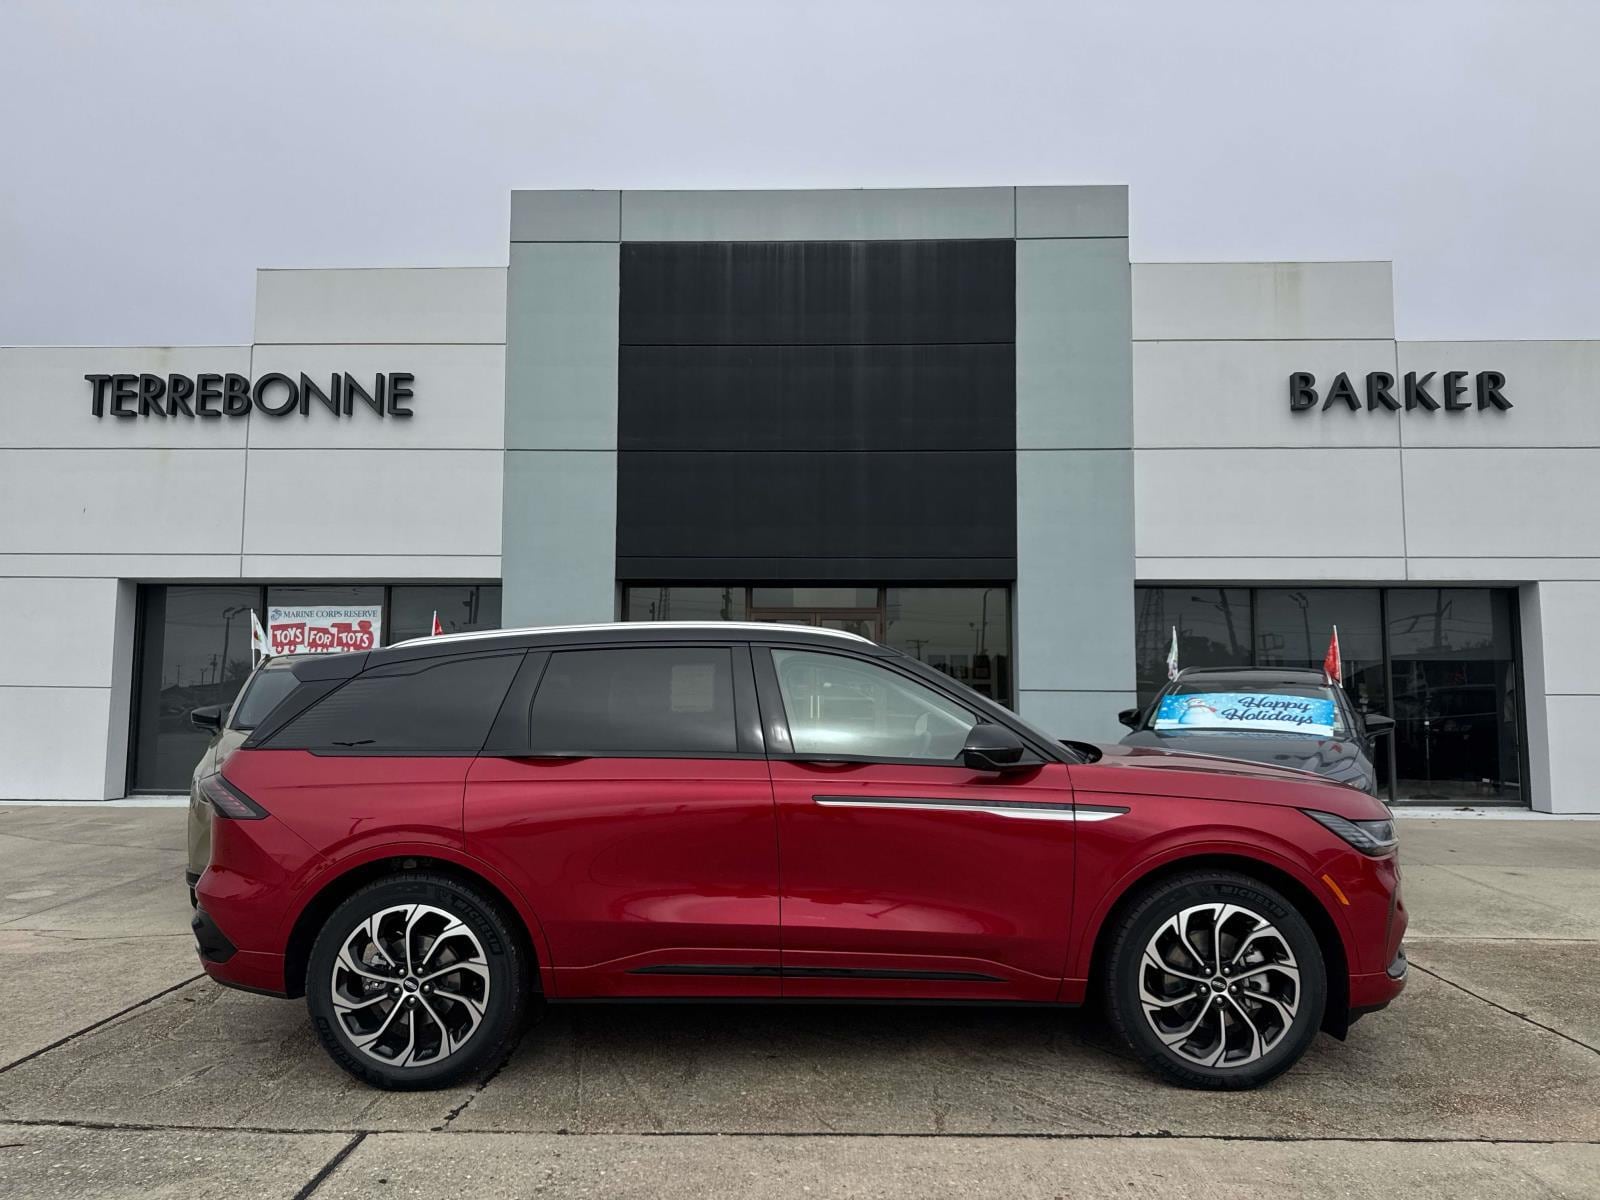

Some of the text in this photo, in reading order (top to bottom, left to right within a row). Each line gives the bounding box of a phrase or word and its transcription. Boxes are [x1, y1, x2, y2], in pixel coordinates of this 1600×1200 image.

[85, 371, 415, 418] TERREBONNE
[1289, 370, 1514, 412] BARKER
[283, 609, 377, 618] MARINE CORPS RESERVE
[274, 627, 370, 648] TOYS FOR TOTS
[1238, 696, 1311, 713] Happy
[1221, 708, 1313, 725] Holidays
[1221, 886, 1288, 919] MICHELIN
